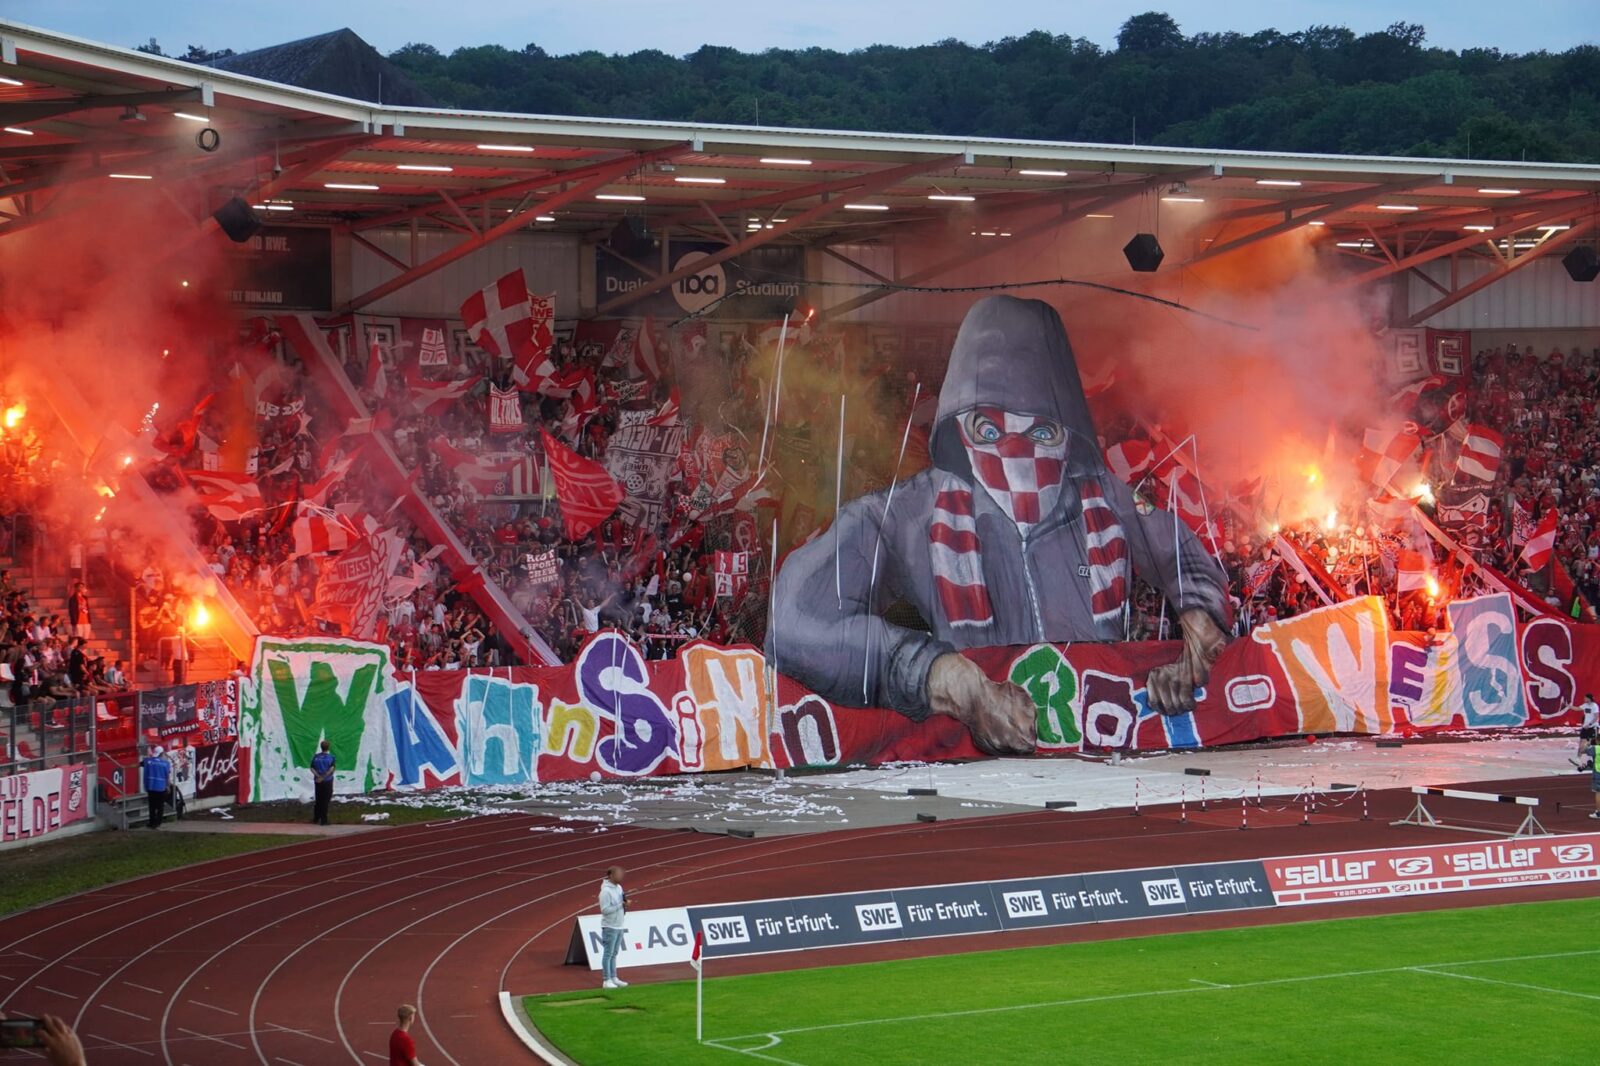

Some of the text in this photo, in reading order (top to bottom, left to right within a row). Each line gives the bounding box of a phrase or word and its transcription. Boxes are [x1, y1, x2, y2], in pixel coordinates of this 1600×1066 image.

[1009, 887, 1129, 914] SWE Für Erfurt.
[1148, 876, 1263, 902] SWE Für Erfurt.
[708, 912, 839, 941] SWE Für Erfurt.
[861, 899, 988, 927] SWE Für Erfurt.
